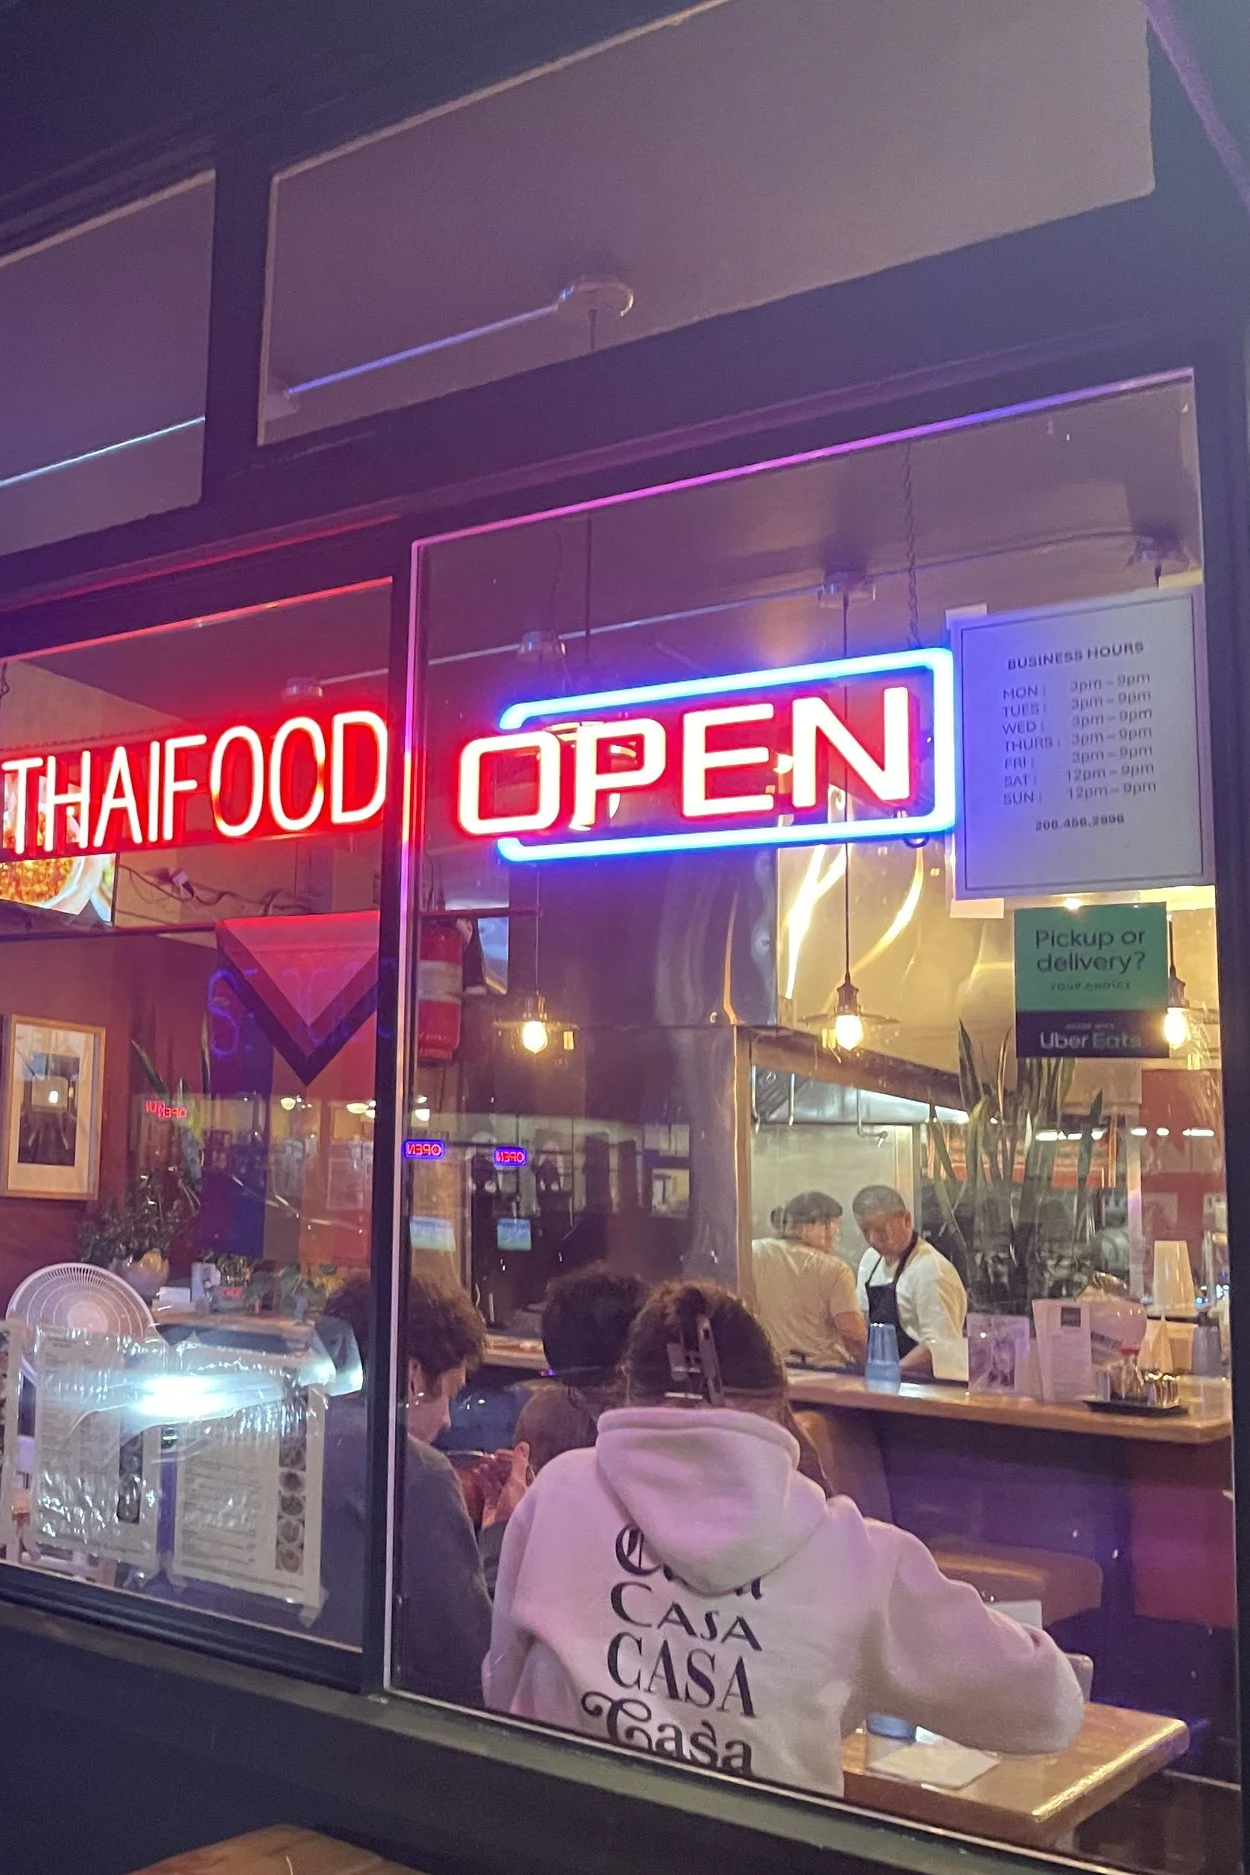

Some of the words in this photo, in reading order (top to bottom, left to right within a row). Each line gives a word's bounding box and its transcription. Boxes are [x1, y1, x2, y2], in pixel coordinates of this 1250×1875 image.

[1007, 650, 1083, 670] BUSINESS
[1087, 640, 1144, 660] HOURS
[1003, 685, 1038, 700] MON
[1003, 703, 1040, 718] TUES
[1002, 720, 1037, 735] WED
[1005, 736, 1053, 753] THURS
[458, 686, 911, 836] OPEN
[1004, 756, 1026, 770] FRI
[1004, 773, 1029, 788] SAT
[1003, 791, 1034, 806] SUN
[1035, 929, 1115, 950] Pickup
[1121, 929, 1146, 947] or
[1036, 951, 1146, 975] delivery?
[1039, 1031, 1087, 1050] Uber
[1092, 1030, 1143, 1050] Eats
[607, 1631, 757, 1719] CASA
